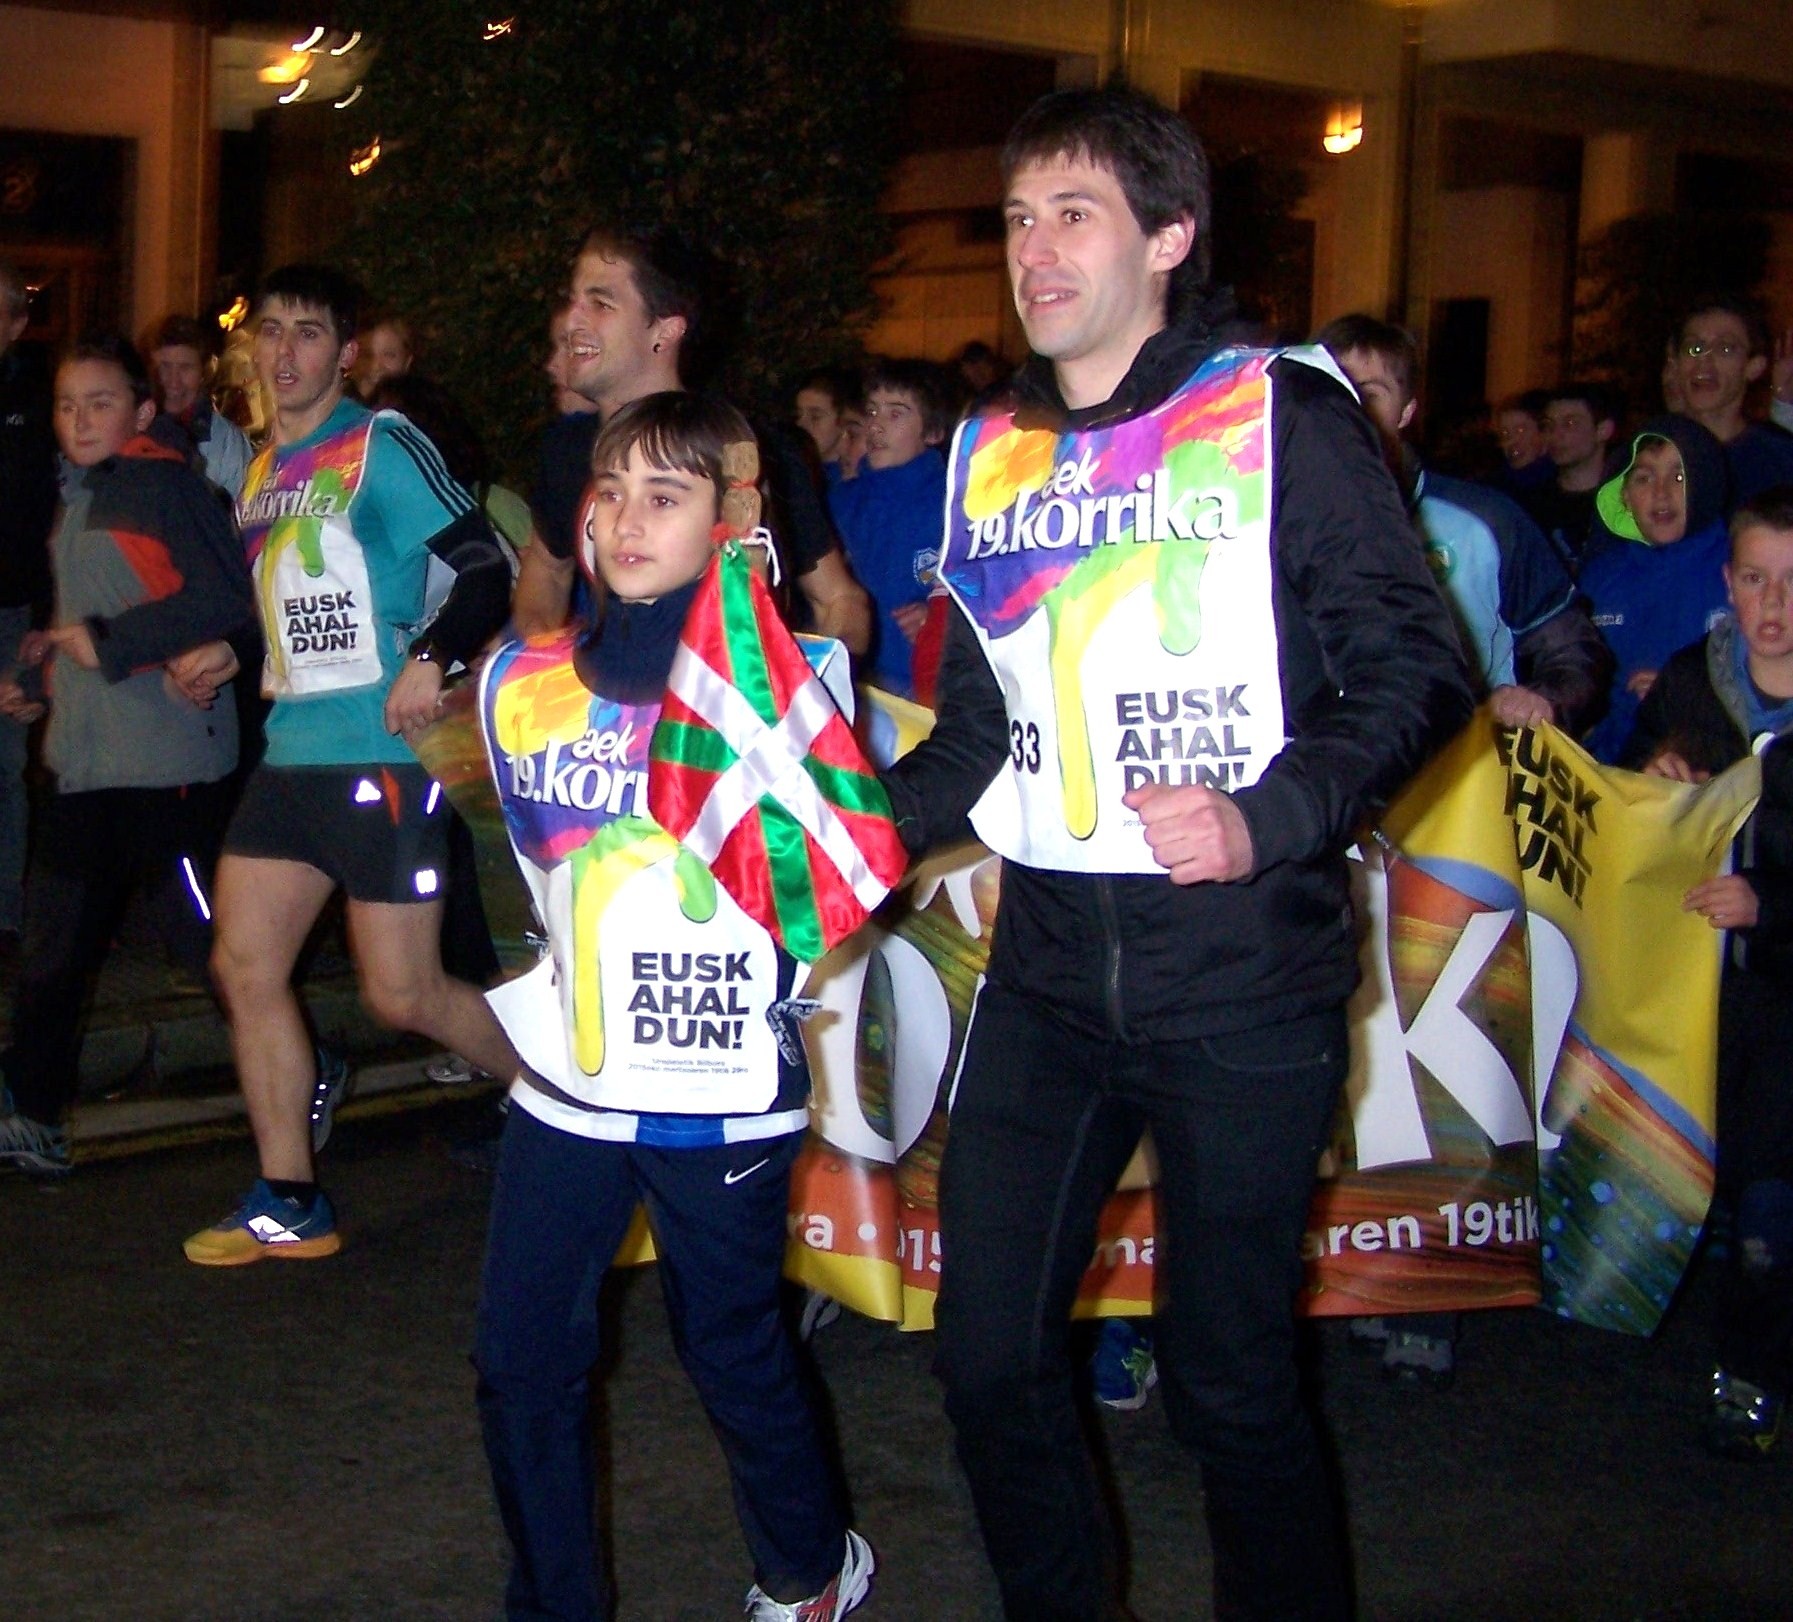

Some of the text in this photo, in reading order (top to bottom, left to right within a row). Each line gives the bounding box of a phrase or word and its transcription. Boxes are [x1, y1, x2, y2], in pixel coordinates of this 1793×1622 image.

[284, 590, 356, 617] EUSK
[286, 612, 359, 637] AHAL
[291, 631, 356, 654] DUN!
[1115, 683, 1251, 727] EUSK
[572, 721, 637, 766] aek
[1115, 724, 1252, 762] AHAL
[632, 951, 753, 983] EUSK
[627, 984, 750, 1016] AHAL
[633, 1015, 744, 1050] DUN!
